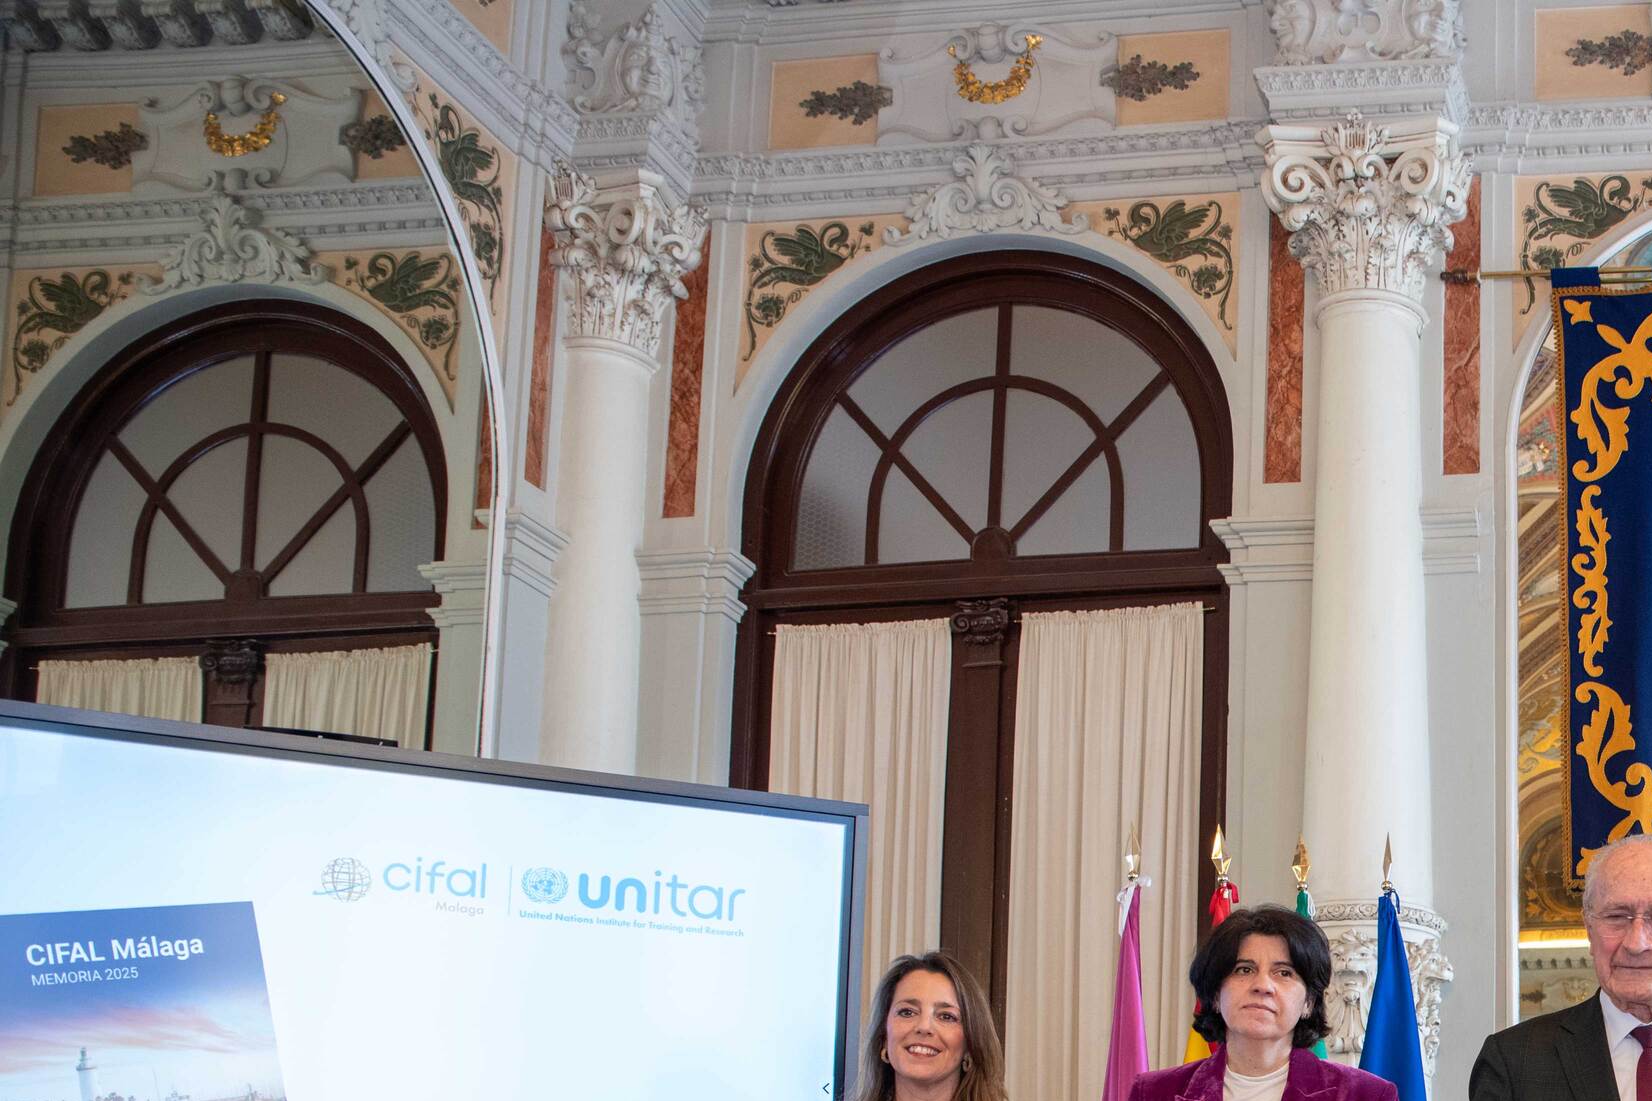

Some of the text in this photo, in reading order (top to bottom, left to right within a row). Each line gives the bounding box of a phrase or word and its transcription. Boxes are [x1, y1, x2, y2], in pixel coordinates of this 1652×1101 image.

[383, 857, 487, 898] cifal
[578, 870, 746, 921] unitar
[519, 910, 553, 921] United
[555, 912, 594, 924] Nations
[26, 936, 204, 967] CIFAL Málaga
[31, 967, 139, 986] MEMORIA 2025
